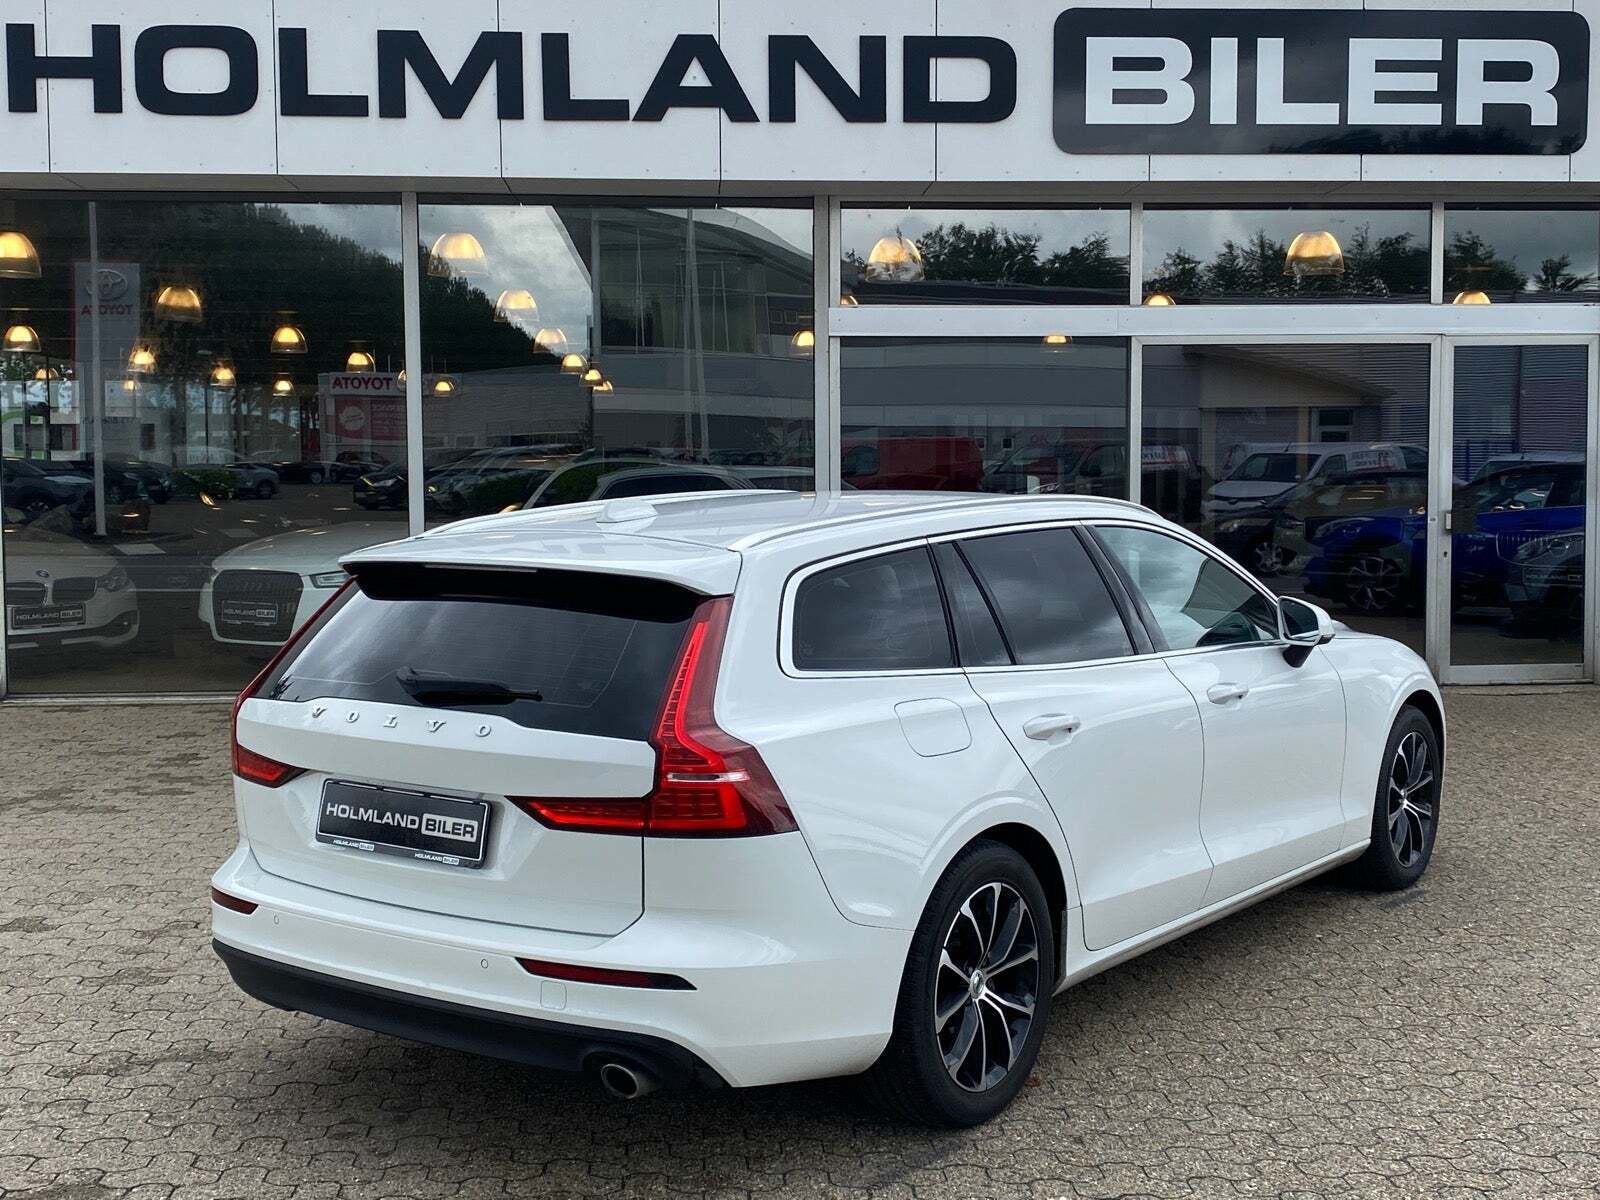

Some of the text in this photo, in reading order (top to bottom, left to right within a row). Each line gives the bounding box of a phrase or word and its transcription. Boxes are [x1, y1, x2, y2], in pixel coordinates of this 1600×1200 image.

[6, 23, 1560, 127] HOLMLAND BILER
[311, 703, 492, 738] VOLVO
[325, 801, 475, 838] HOLMLAND BILER
[333, 839, 374, 851] HOLMLAND BILER
[414, 852, 459, 865] HOLMLAND BILER
